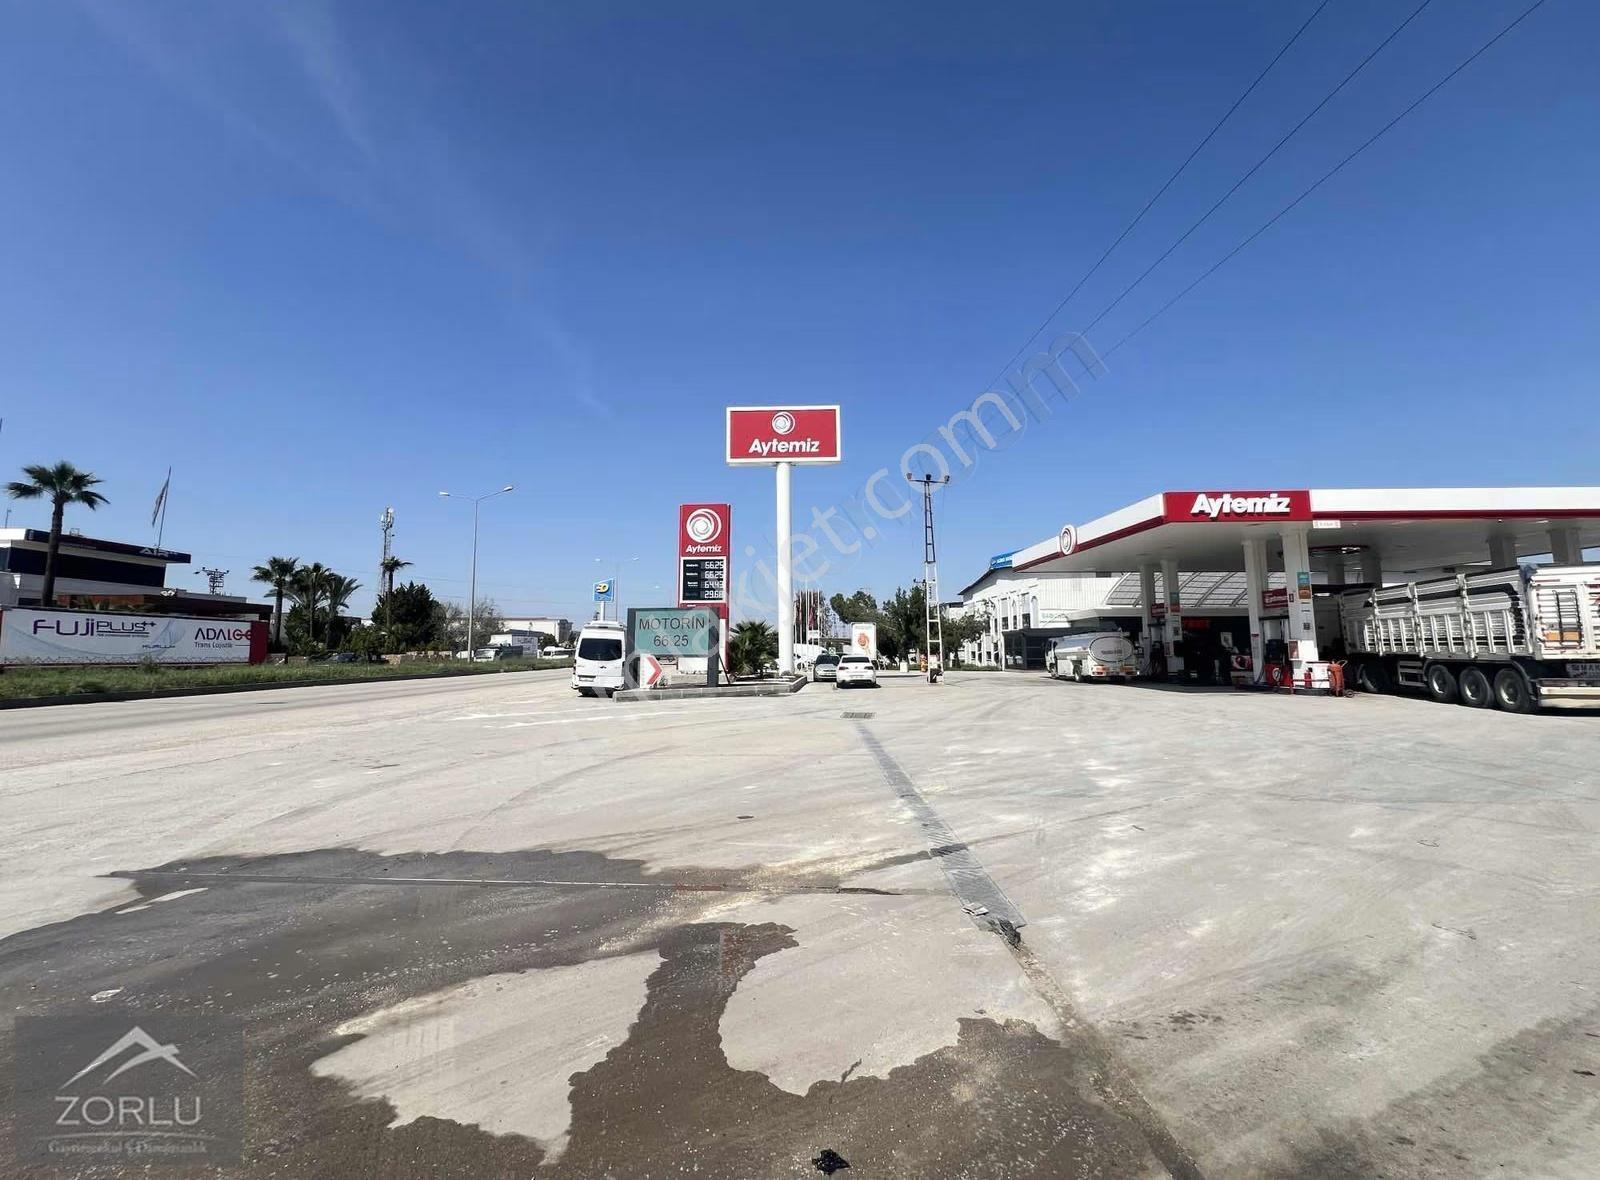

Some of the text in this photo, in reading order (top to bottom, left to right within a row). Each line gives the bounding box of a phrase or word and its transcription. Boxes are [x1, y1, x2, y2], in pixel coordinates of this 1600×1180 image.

[748, 437, 820, 457] Aytemiz
[1189, 492, 1291, 519] Aytemiz
[685, 544, 722, 554] Aytemiz
